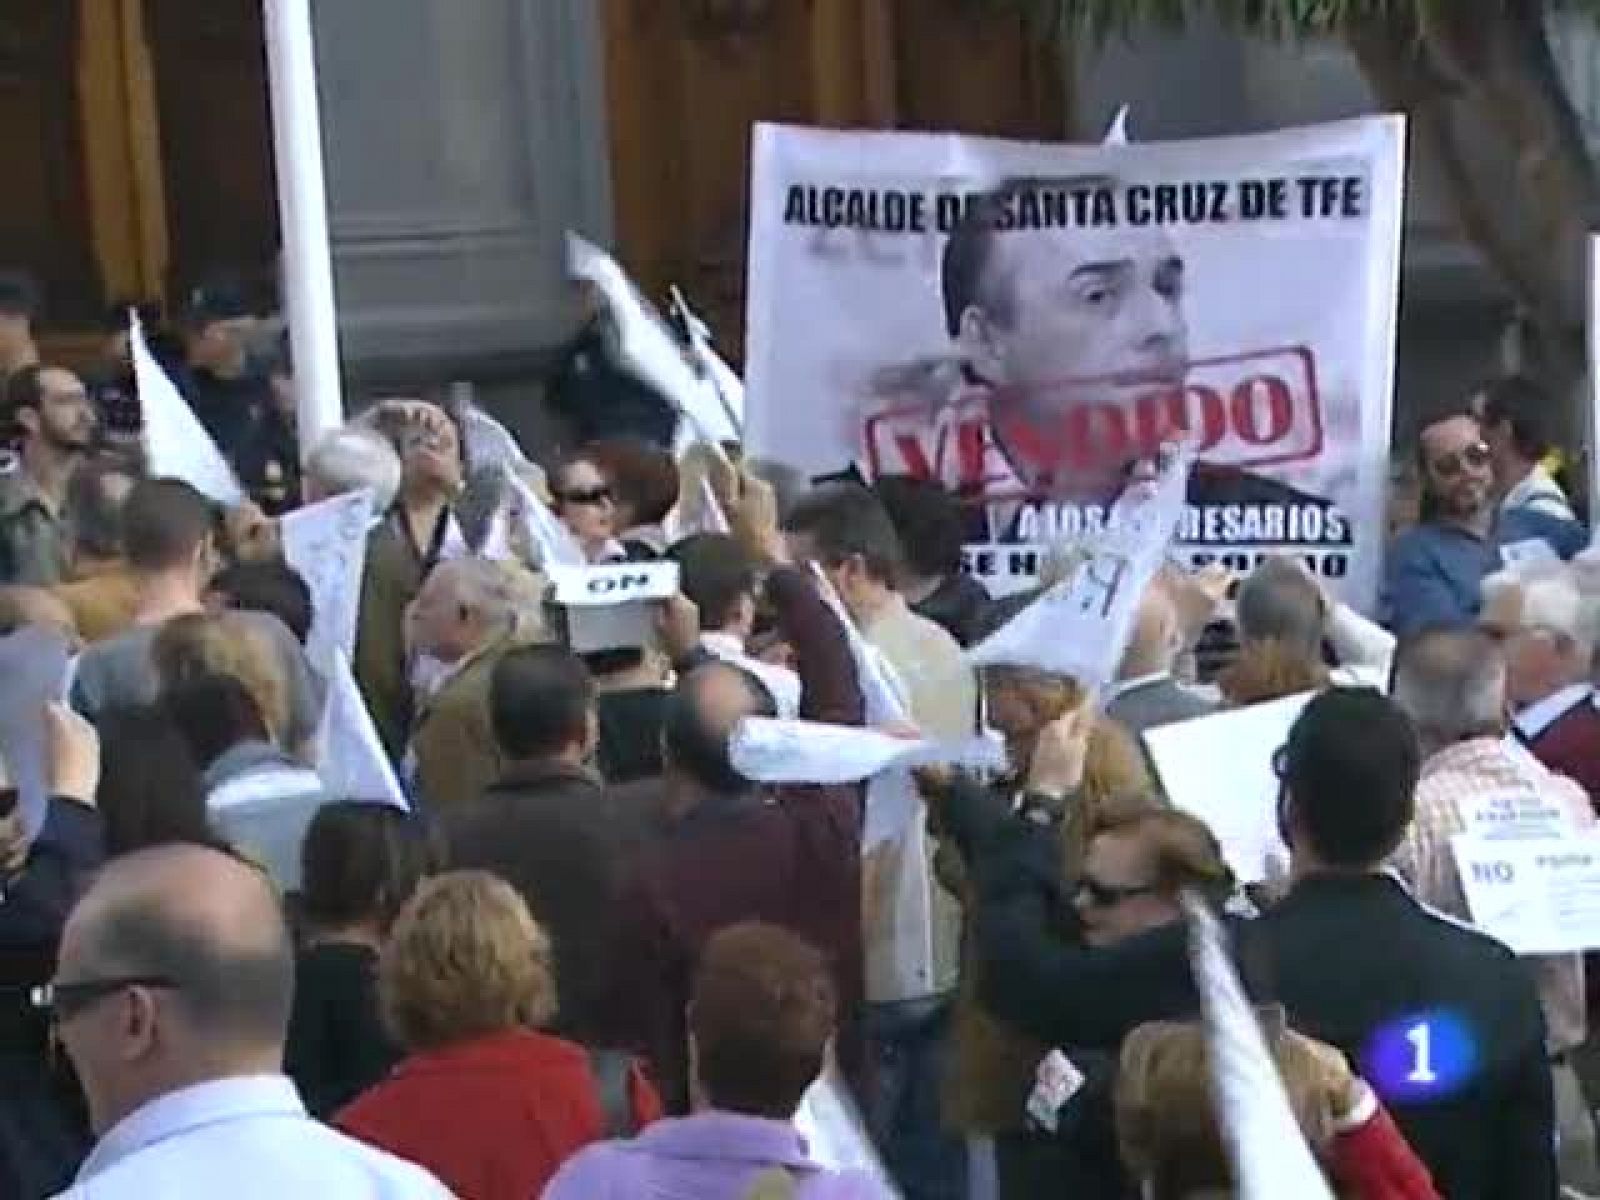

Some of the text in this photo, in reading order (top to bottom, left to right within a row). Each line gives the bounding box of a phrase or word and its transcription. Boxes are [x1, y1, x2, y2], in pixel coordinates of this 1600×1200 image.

[783, 184, 926, 232] ALCALDE
[995, 187, 1117, 231] SANTA
[1125, 180, 1230, 226] CRUZ
[1239, 178, 1287, 219] DE
[1296, 175, 1362, 218] TFE
